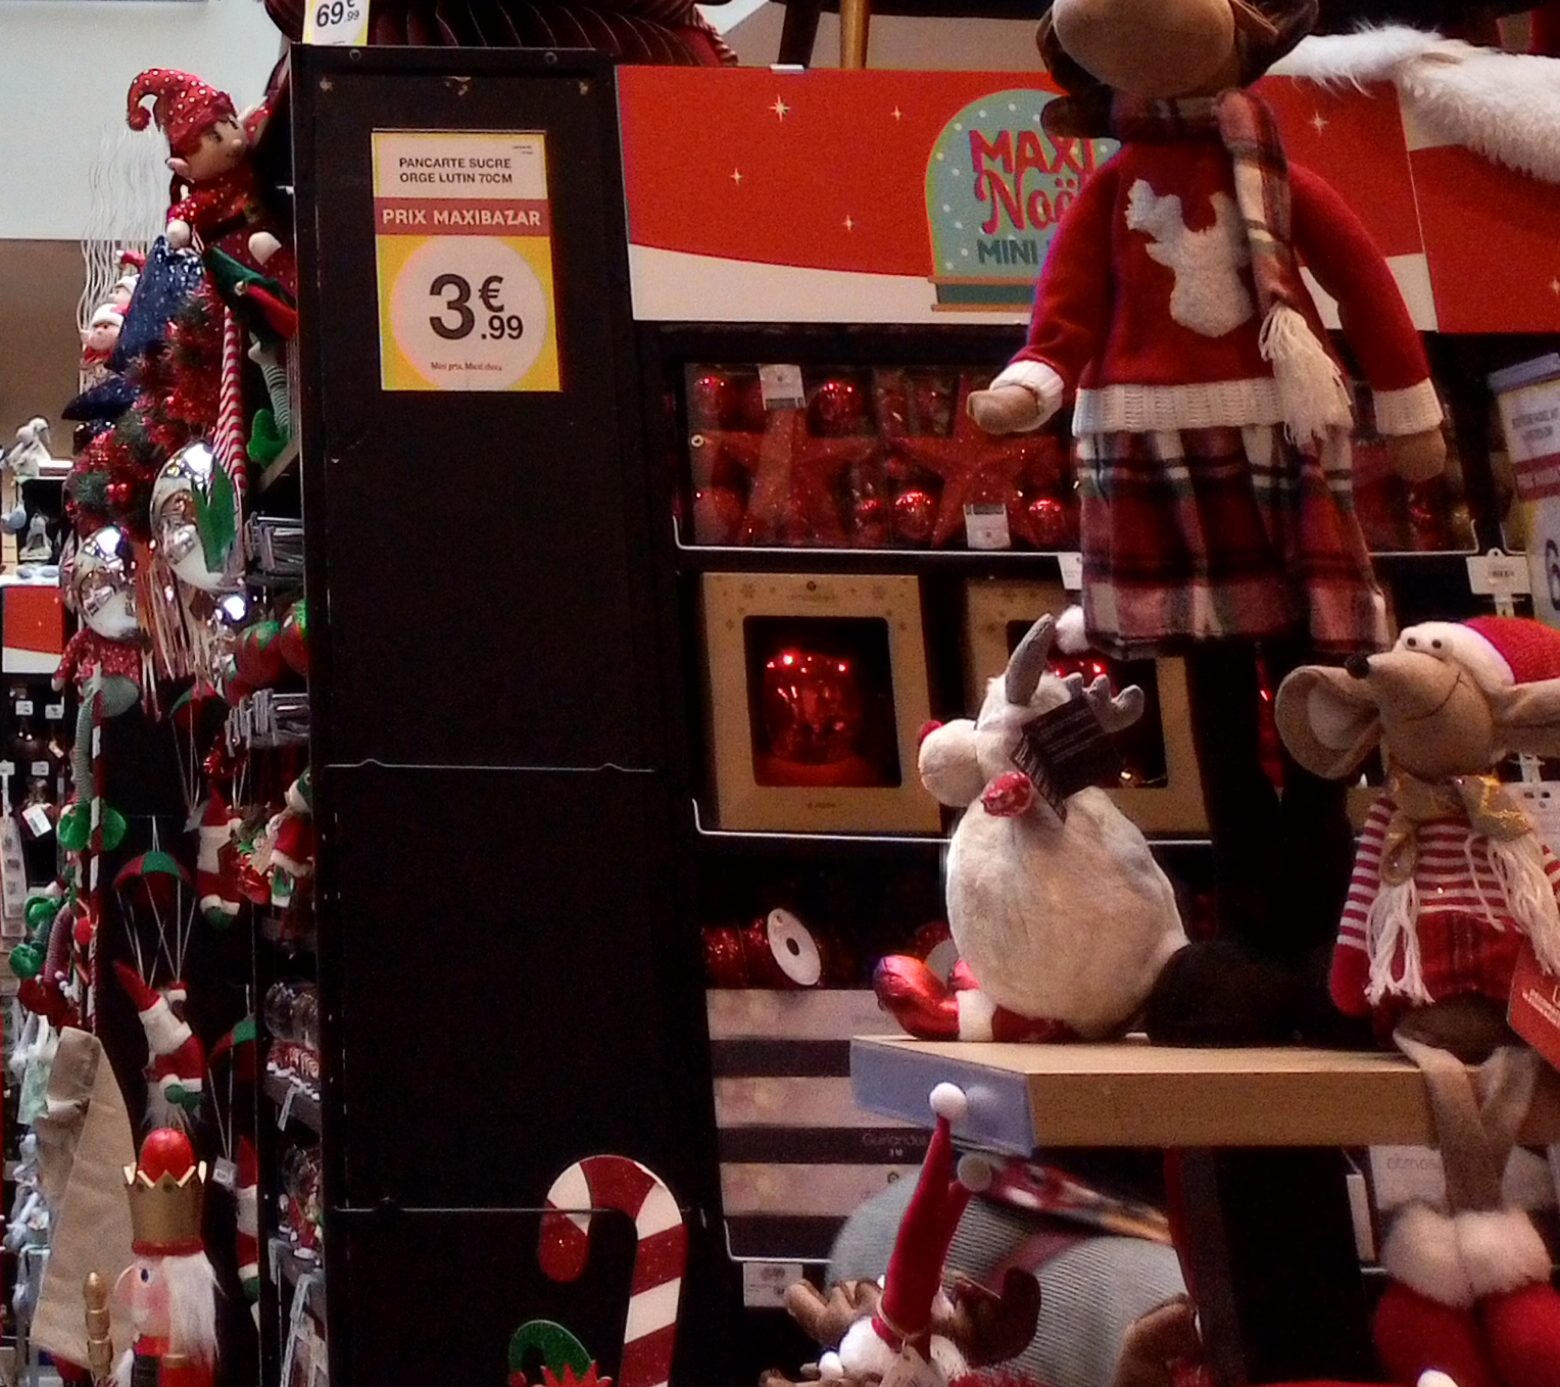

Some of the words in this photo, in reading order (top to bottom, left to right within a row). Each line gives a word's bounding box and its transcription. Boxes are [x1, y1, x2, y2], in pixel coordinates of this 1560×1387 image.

[317, 1, 344, 27] 69
[399, 157, 465, 168] PANCARTE
[469, 158, 511, 169] SUCRE
[969, 130, 1097, 175] MAXI
[400, 172, 435, 183] ORGE
[439, 173, 475, 183] LUTIN
[479, 173, 513, 184] 70CM
[974, 169, 1077, 234] Noë
[382, 208, 427, 225] PRIX
[433, 209, 541, 226] MAXIBAZAR
[976, 239, 1039, 265] MINI
[429, 273, 475, 340] 3
[478, 275, 505, 313] €
